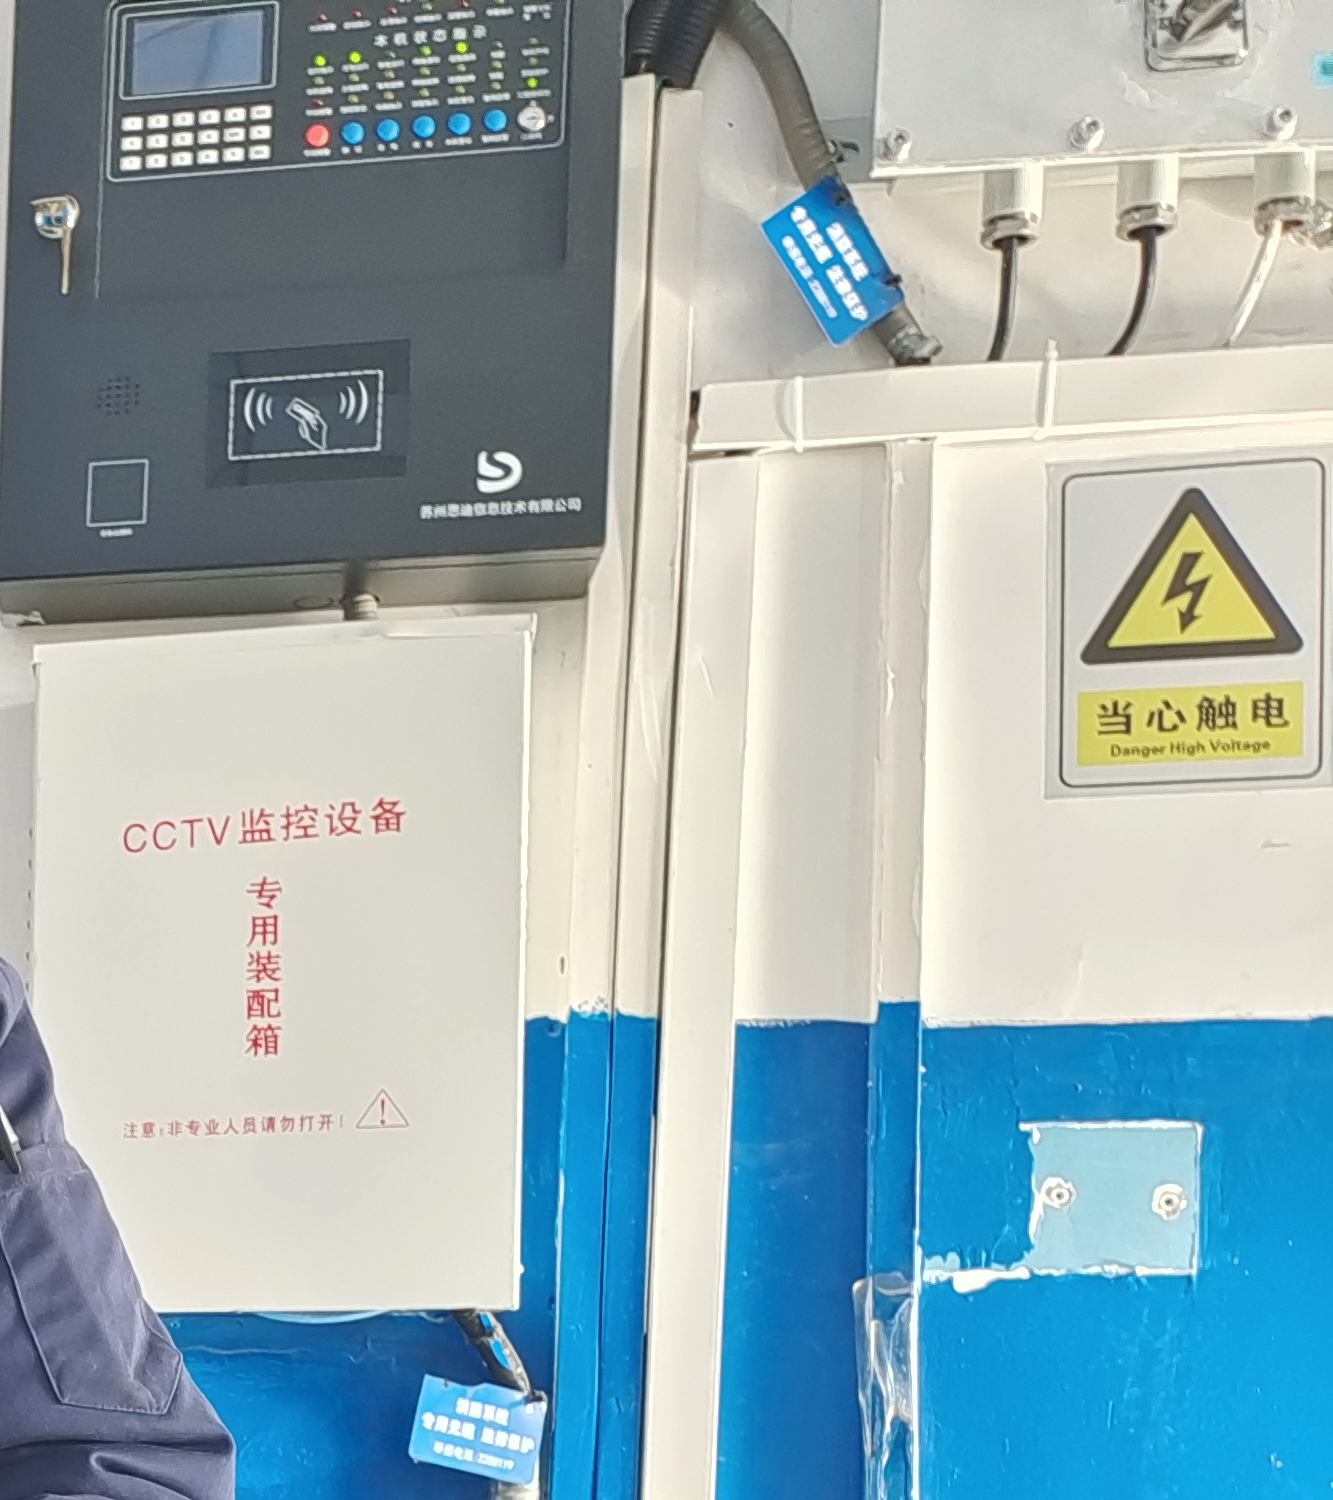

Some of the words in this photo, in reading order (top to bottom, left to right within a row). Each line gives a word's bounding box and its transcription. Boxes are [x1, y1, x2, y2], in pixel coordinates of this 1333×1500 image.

[1097, 692, 1290, 736] 当心触电
[1110, 743, 1167, 759] Danger
[1169, 740, 1206, 756] High
[1209, 736, 1272, 754] Voltage
[244, 875, 284, 1058] 专用装配箱
